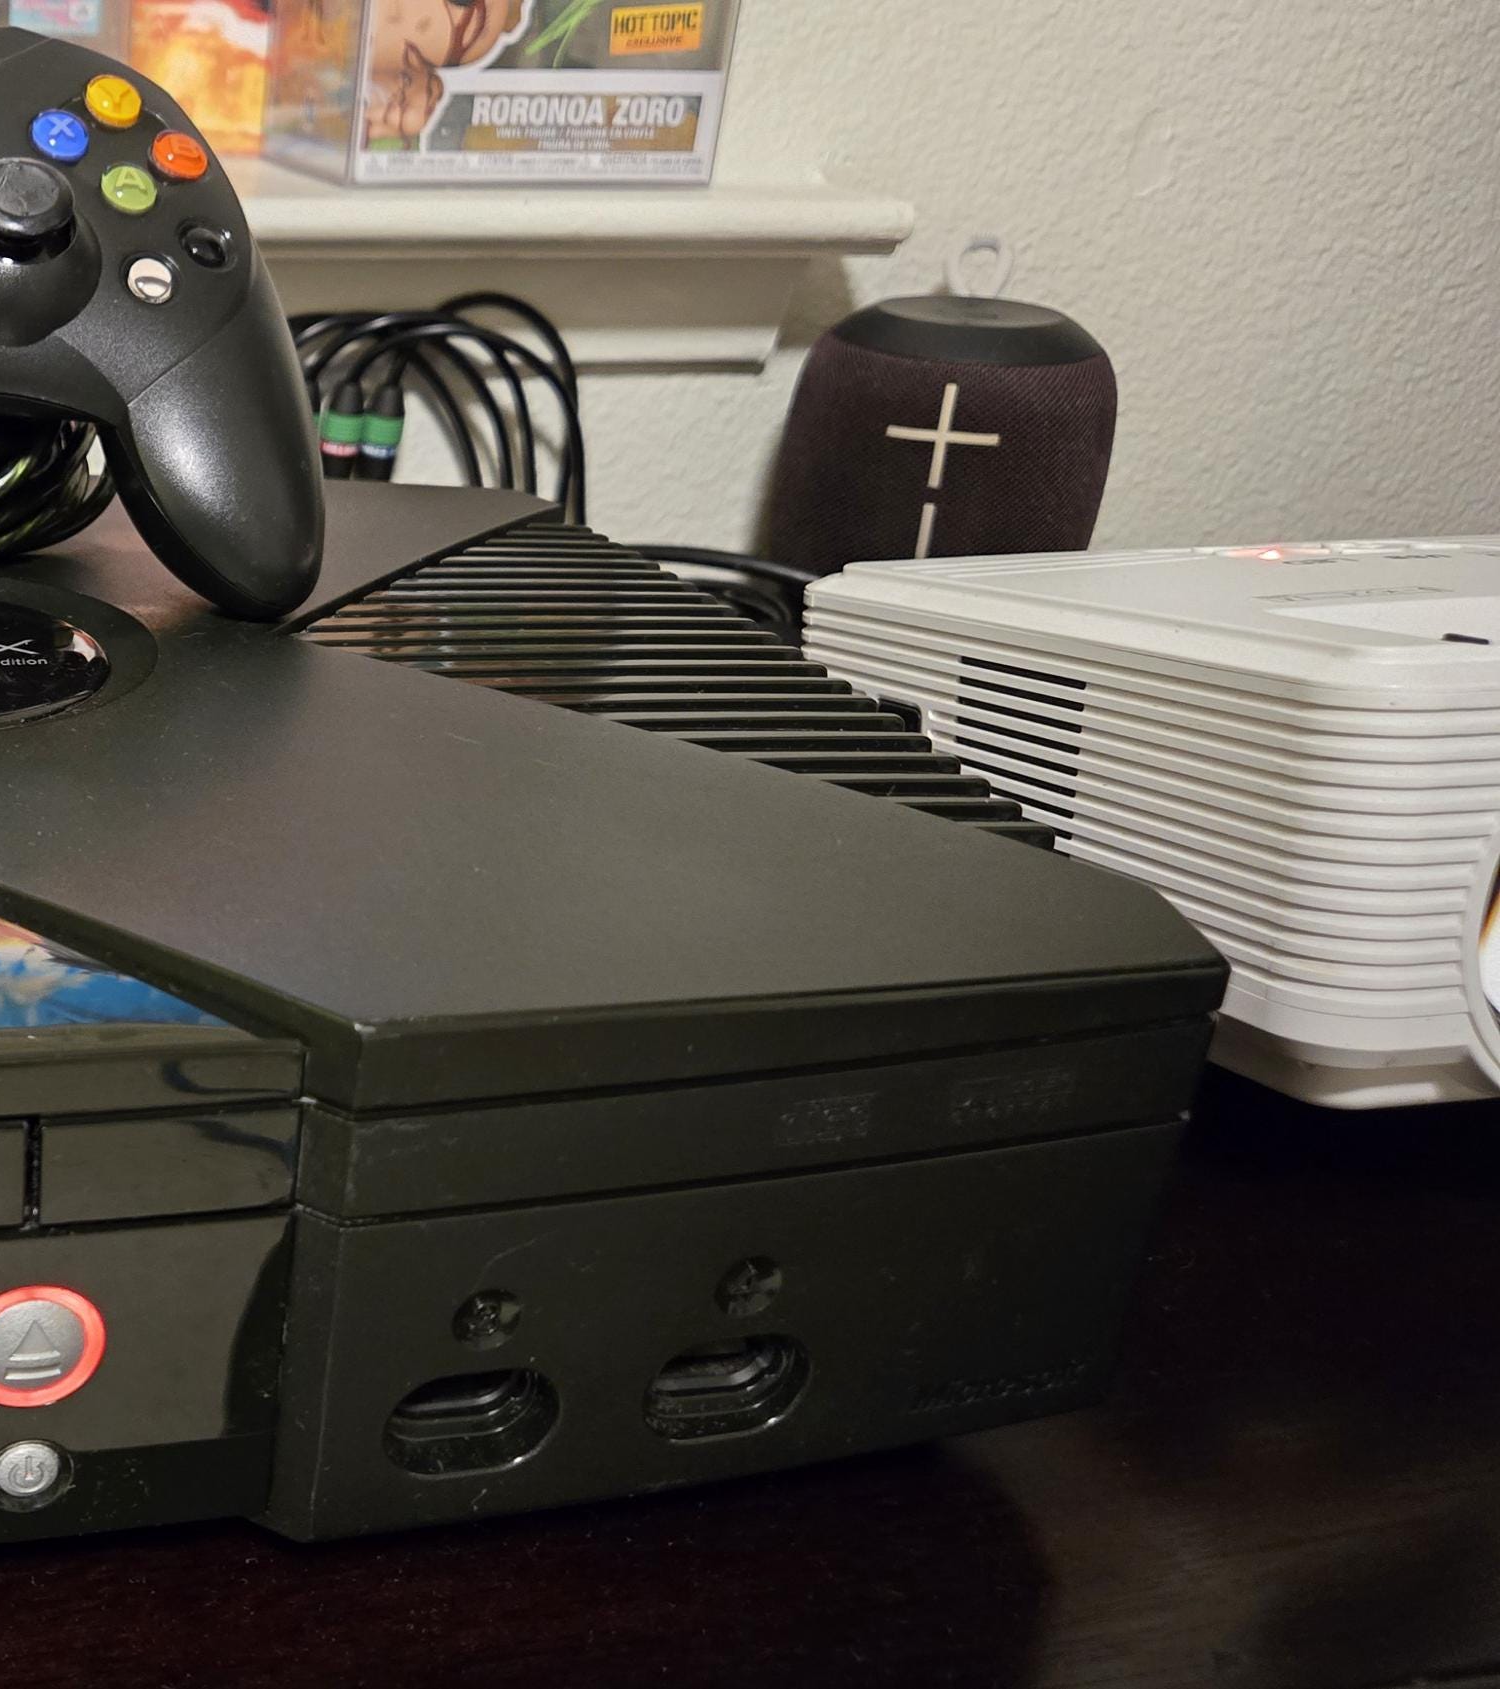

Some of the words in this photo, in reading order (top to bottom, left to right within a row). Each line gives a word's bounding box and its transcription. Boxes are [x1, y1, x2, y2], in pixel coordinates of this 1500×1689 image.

[613, 14, 646, 34] HOT
[652, 9, 698, 32] TOPIC
[96, 84, 132, 113] Y
[471, 95, 604, 127] RORONOA
[611, 95, 685, 128] ZORO
[47, 115, 75, 140] X
[167, 136, 202, 161] B
[114, 166, 148, 195] A
